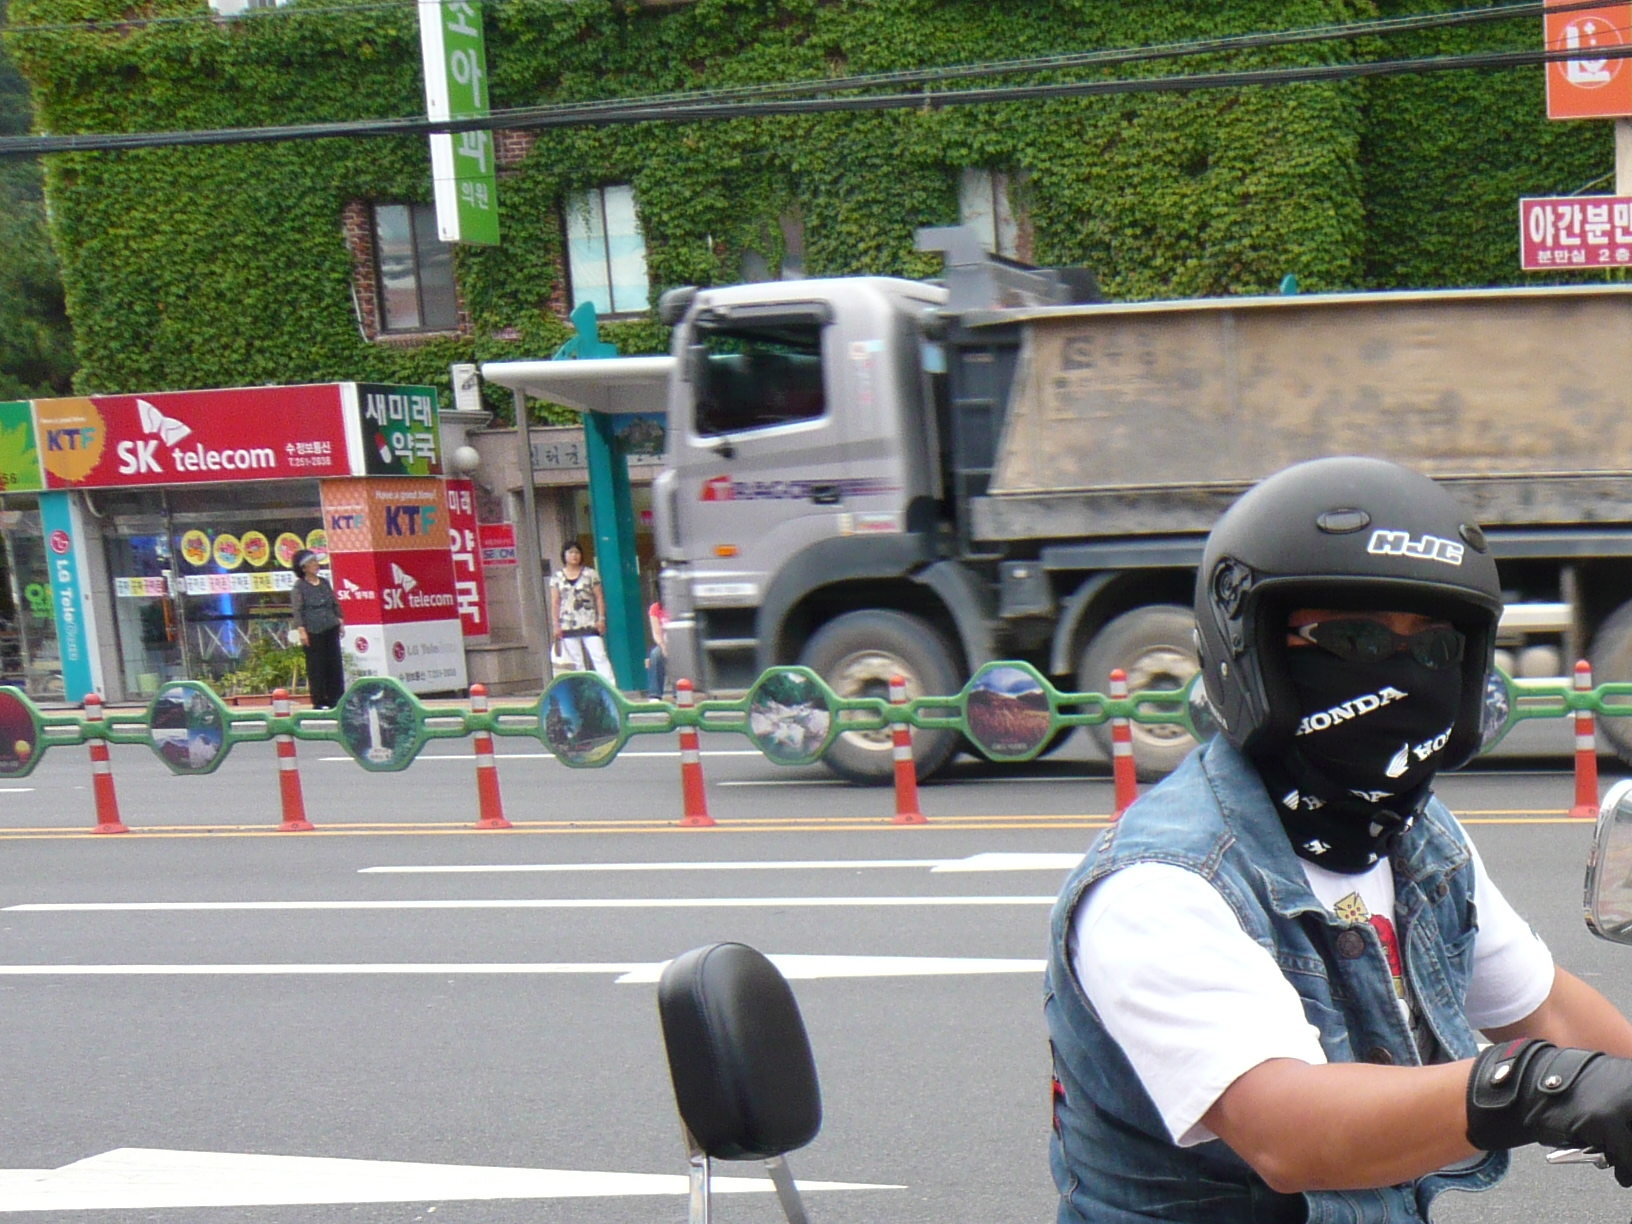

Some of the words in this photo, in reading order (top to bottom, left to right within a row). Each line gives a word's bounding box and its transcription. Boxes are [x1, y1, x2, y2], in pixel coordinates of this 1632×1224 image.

[1598, 248, 1611, 262] 2
[365, 393, 433, 427] 새미래
[46, 427, 97, 452] KTF
[391, 431, 437, 464] 약국
[116, 440, 164, 475] SK
[171, 442, 277, 473] telecom
[331, 514, 365, 530] KTF
[385, 505, 438, 537] KTF
[1367, 530, 1464, 566] HJC
[56, 559, 72, 583] LG
[383, 588, 405, 610] SK
[408, 590, 454, 608] telecom
[1295, 686, 1409, 737] HONDA
